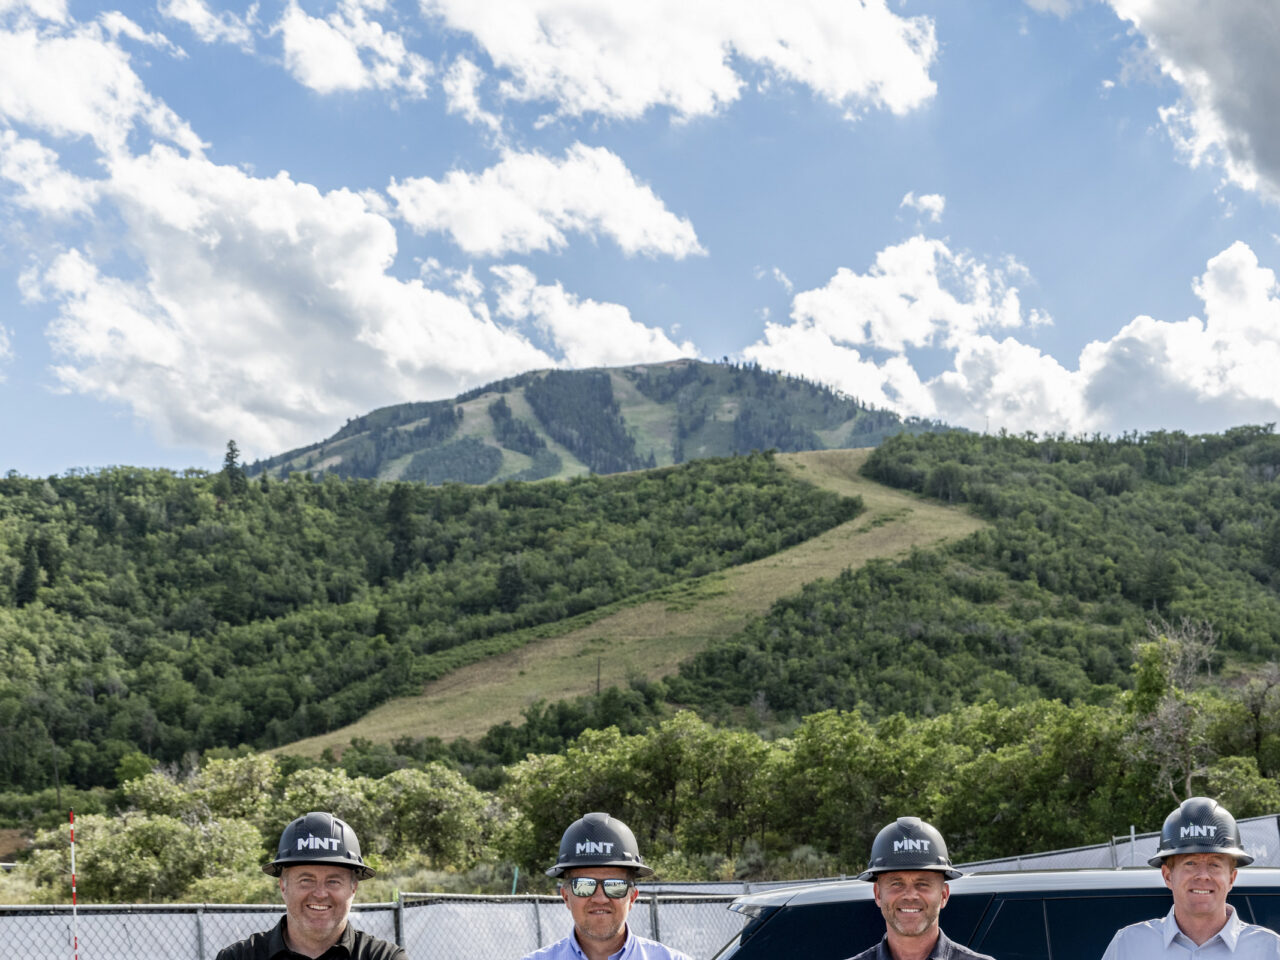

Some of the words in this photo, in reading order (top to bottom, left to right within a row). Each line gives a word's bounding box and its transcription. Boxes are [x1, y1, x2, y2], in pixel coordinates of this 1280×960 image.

[1180, 822, 1217, 838] MINT
[297, 833, 341, 851] MINT
[575, 838, 614, 854] MINT
[893, 836, 931, 852] MINT
